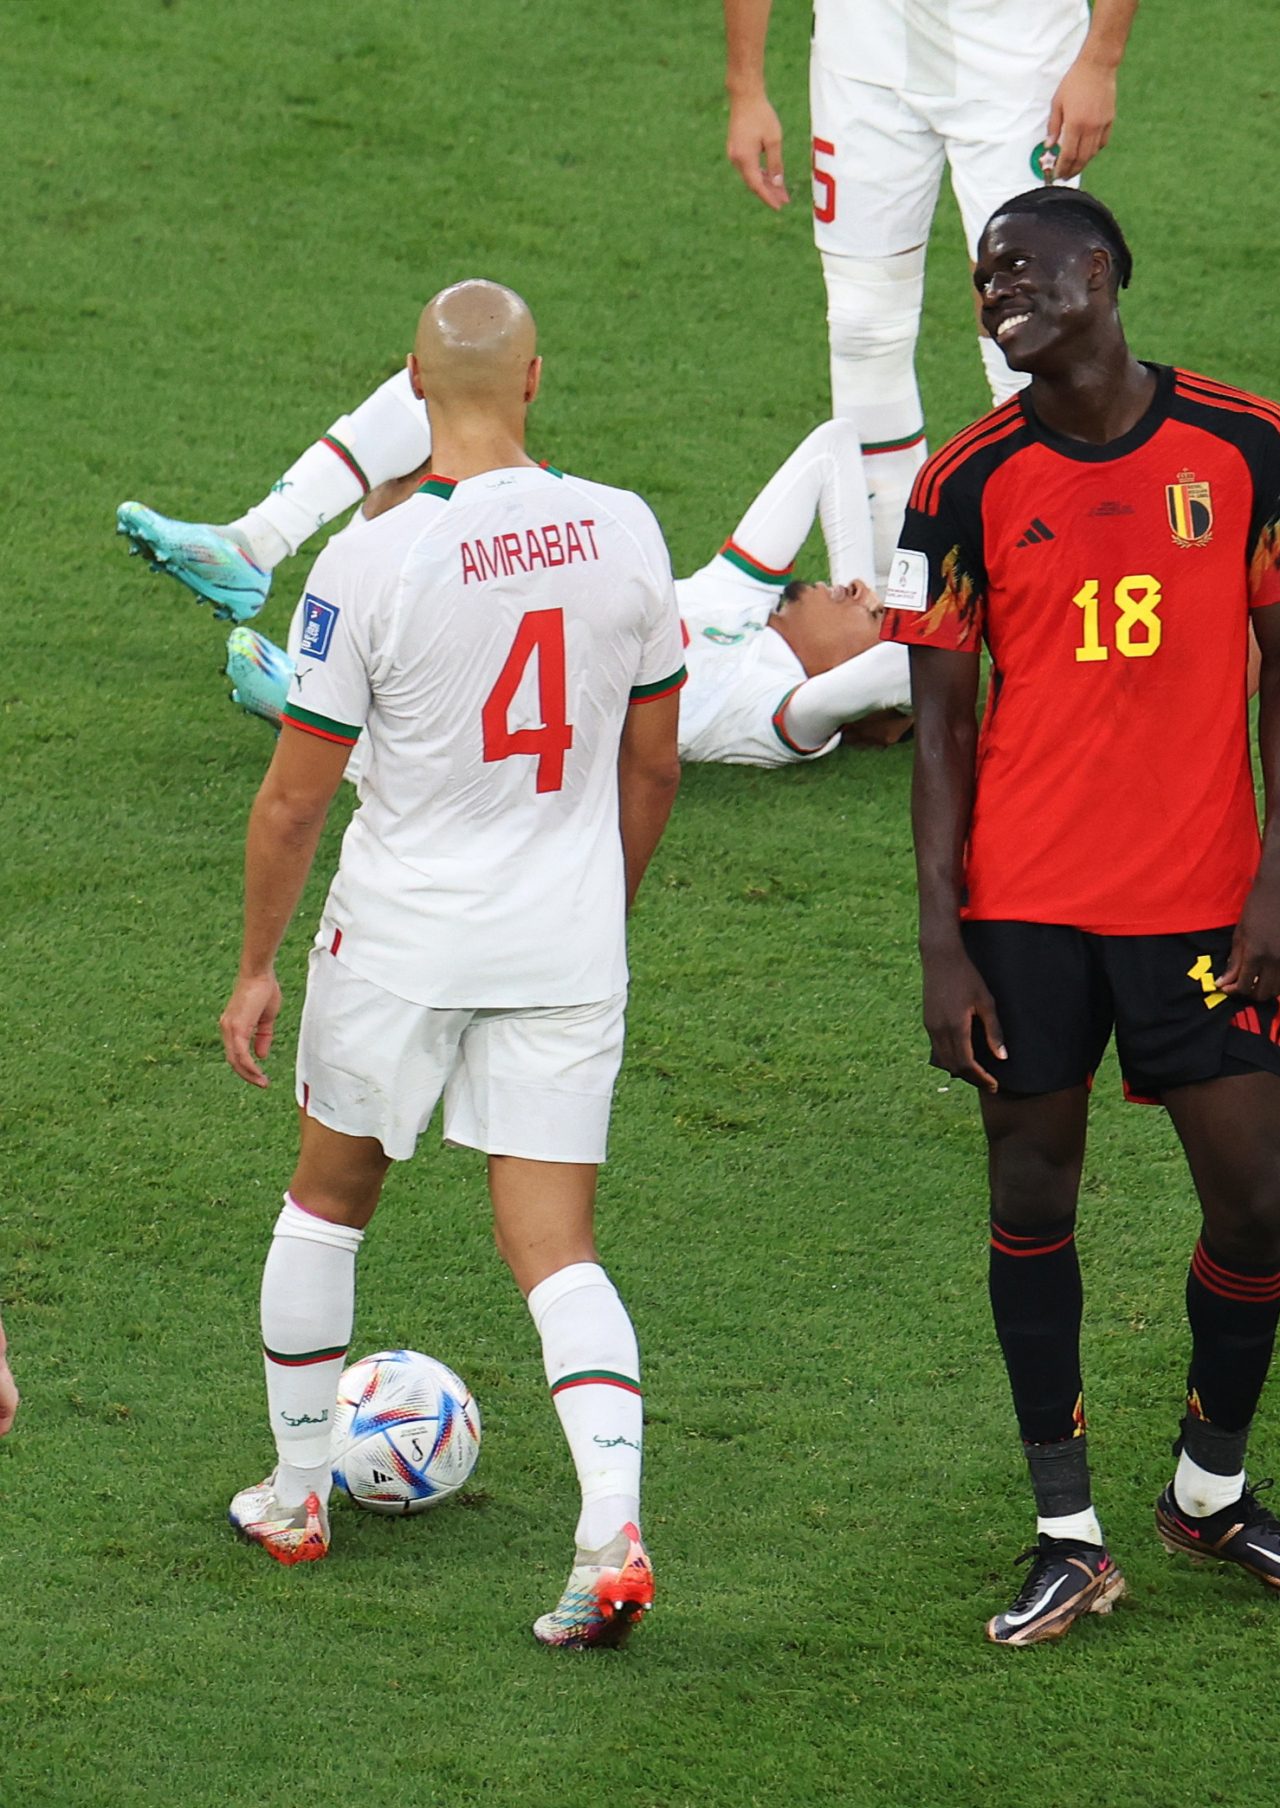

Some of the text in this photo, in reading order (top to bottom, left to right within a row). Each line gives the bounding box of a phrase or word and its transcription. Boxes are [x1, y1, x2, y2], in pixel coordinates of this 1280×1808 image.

[460, 519, 599, 585] AMRABAT
[1072, 574, 1162, 662] 18
[482, 607, 573, 794] 4
[1187, 955, 1228, 1010] 1
